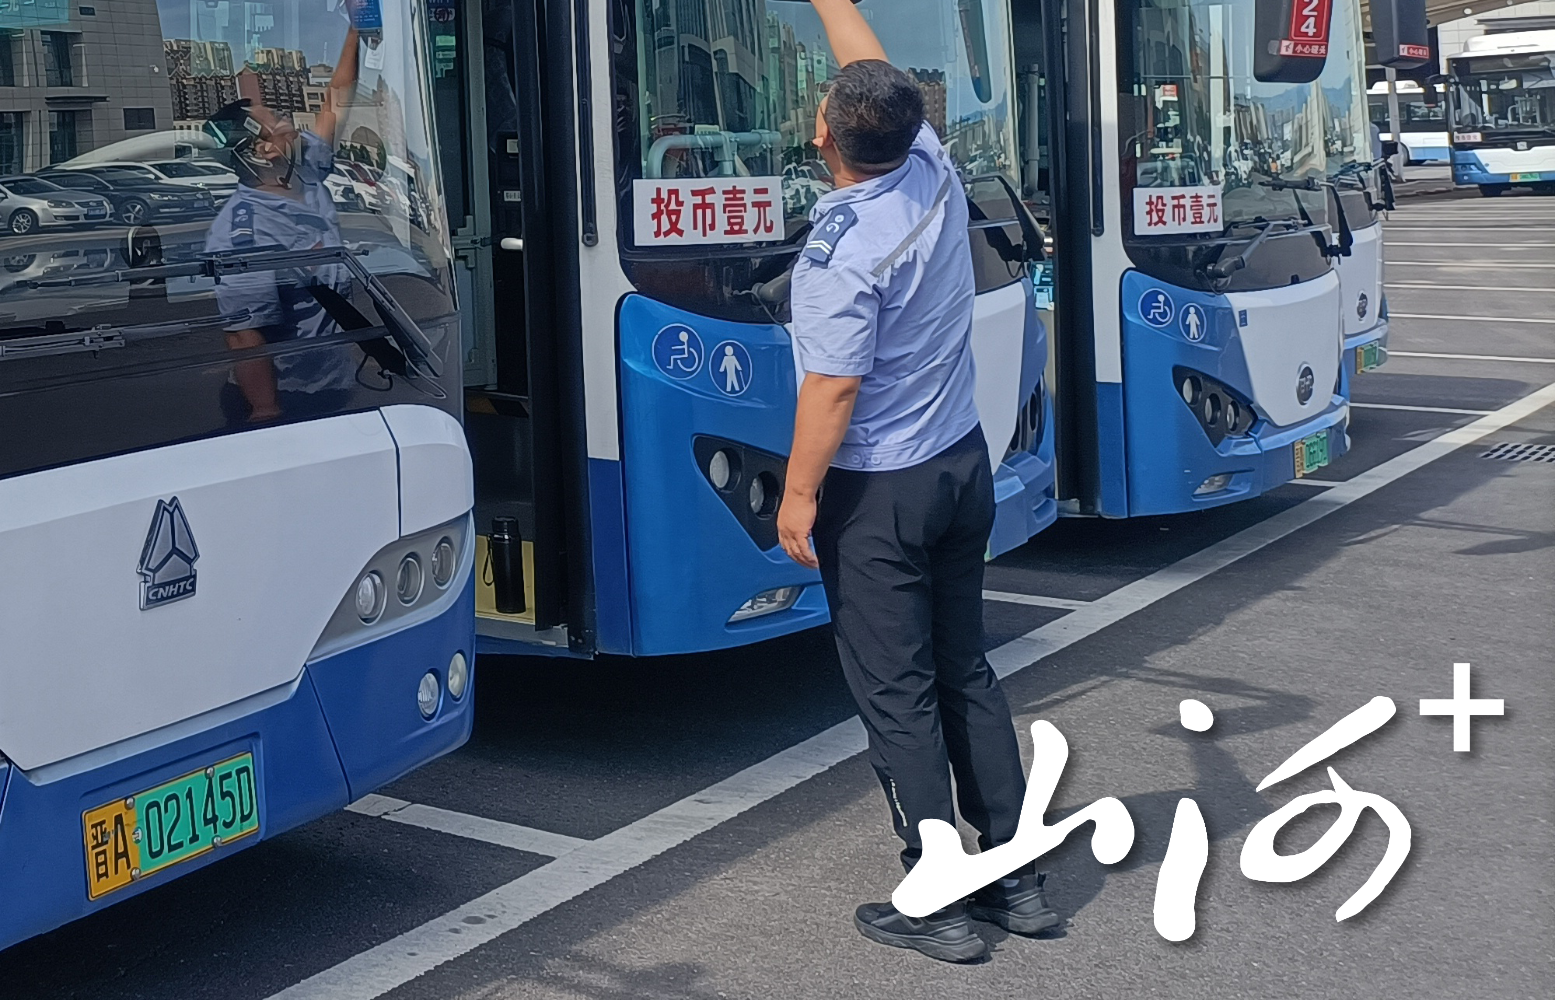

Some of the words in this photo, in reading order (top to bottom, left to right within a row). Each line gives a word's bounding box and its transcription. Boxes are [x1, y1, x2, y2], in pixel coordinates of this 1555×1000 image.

[650, 185, 774, 239] 投币壹元
[1145, 192, 1219, 227] 投币壹元
[148, 577, 195, 600] CNHTC
